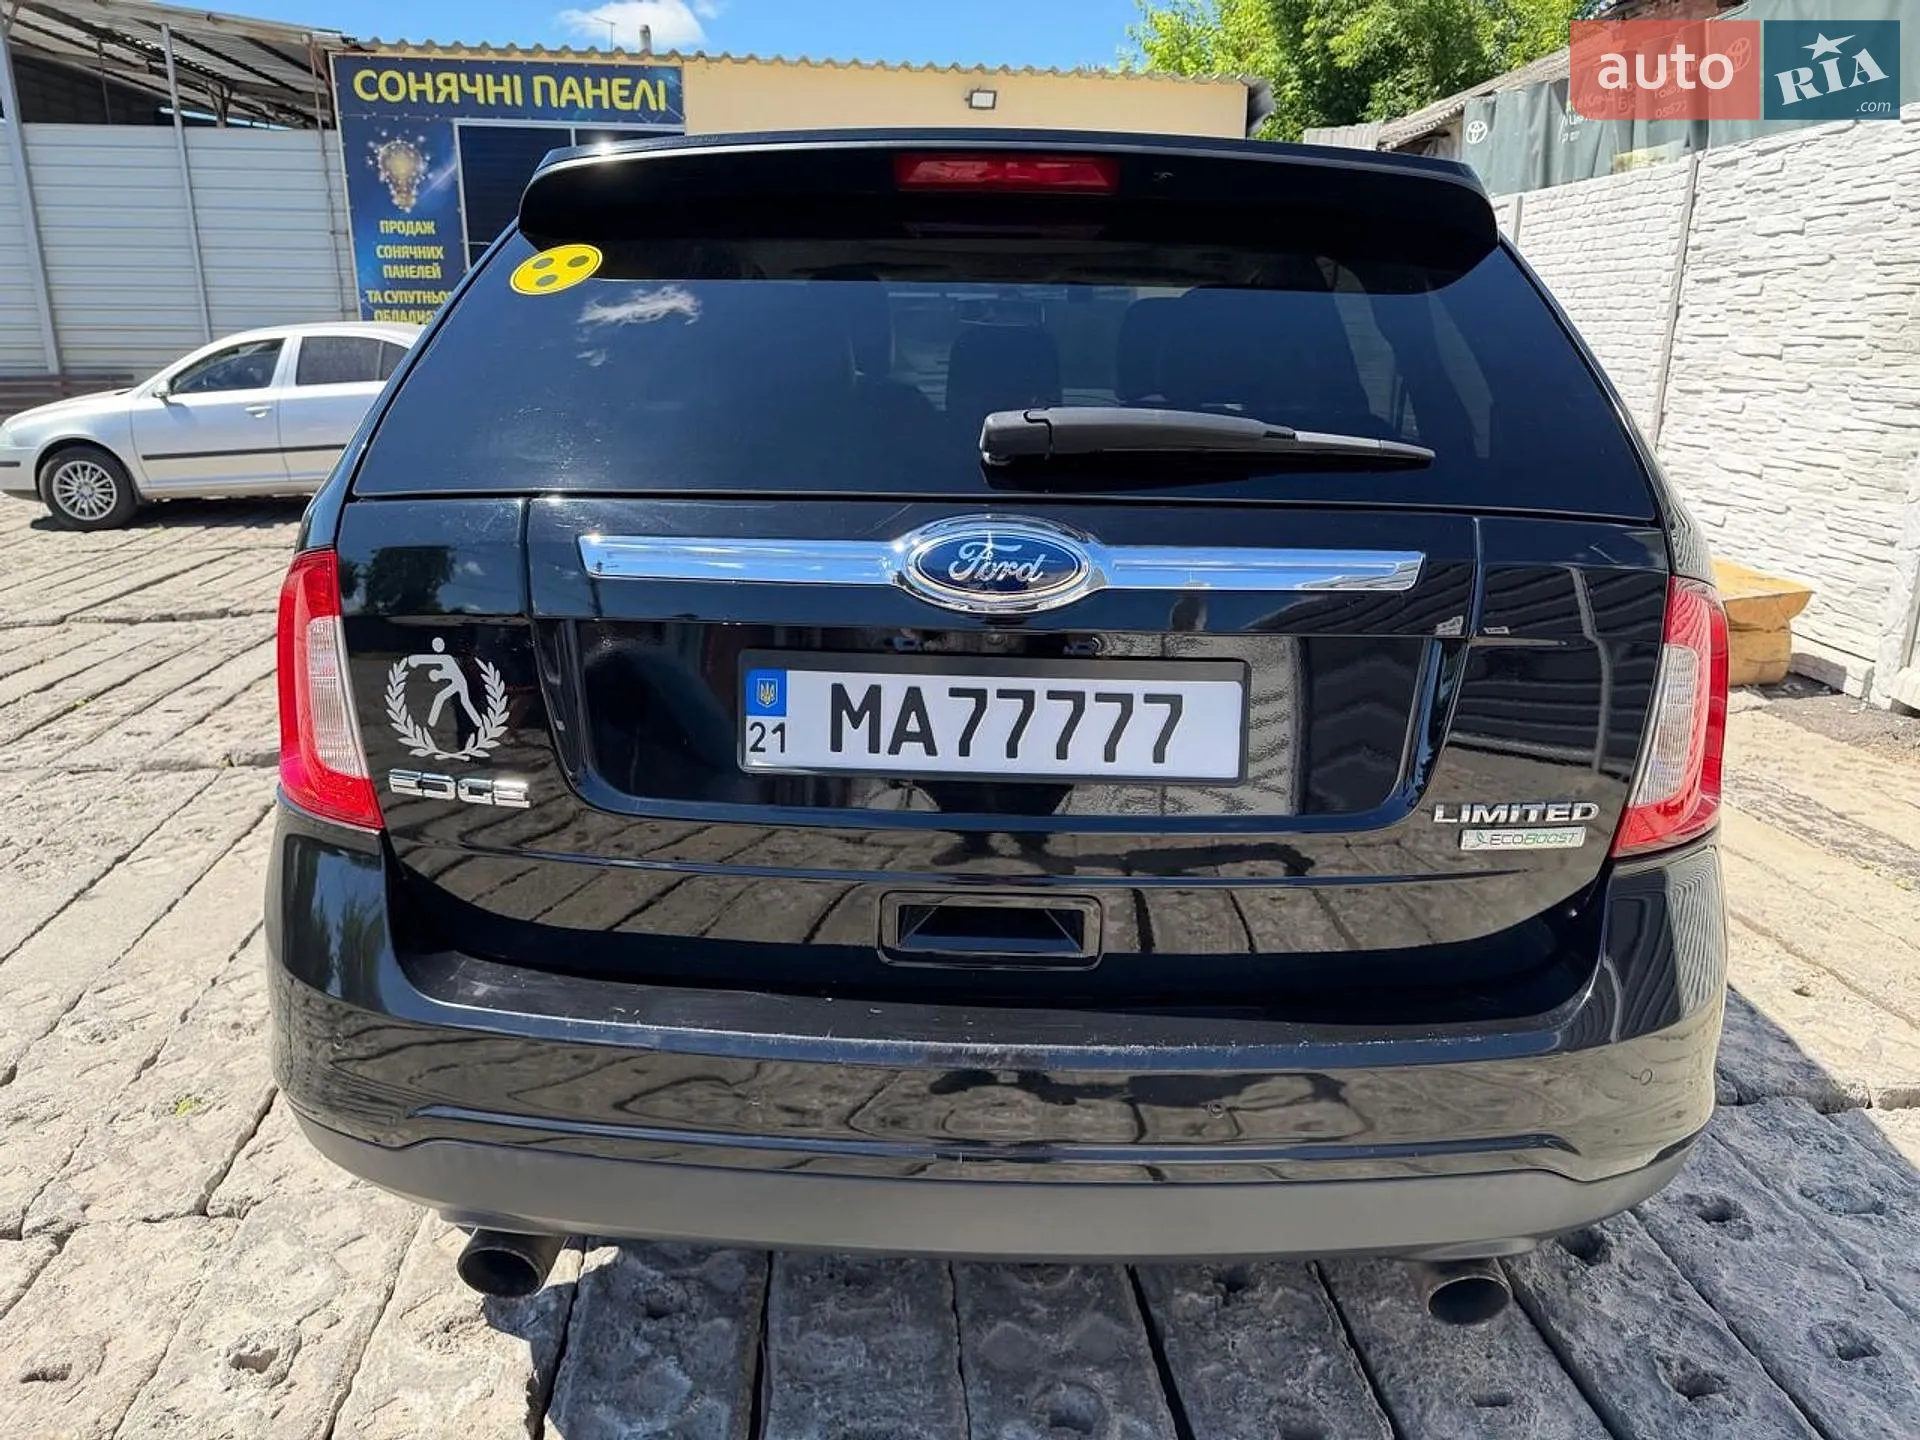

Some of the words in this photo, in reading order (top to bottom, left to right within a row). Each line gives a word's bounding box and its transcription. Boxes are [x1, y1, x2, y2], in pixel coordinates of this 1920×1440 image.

[353, 69, 524, 107] СОНЯЧНІ
[533, 75, 667, 112] ПАНЕЛІ
[380, 220, 436, 236] ПРОДАЖ
[376, 245, 444, 260] СОНЯЧНИХ
[383, 262, 442, 279] ПАНЕЛЕЙ
[366, 290, 382, 304] ТА
[948, 541, 1046, 583] Ford
[748, 722, 786, 754] 21
[389, 768, 530, 808] EDGE
[1433, 802, 1600, 823] LIMITED
[1489, 832, 1577, 846] ECOBOOST
